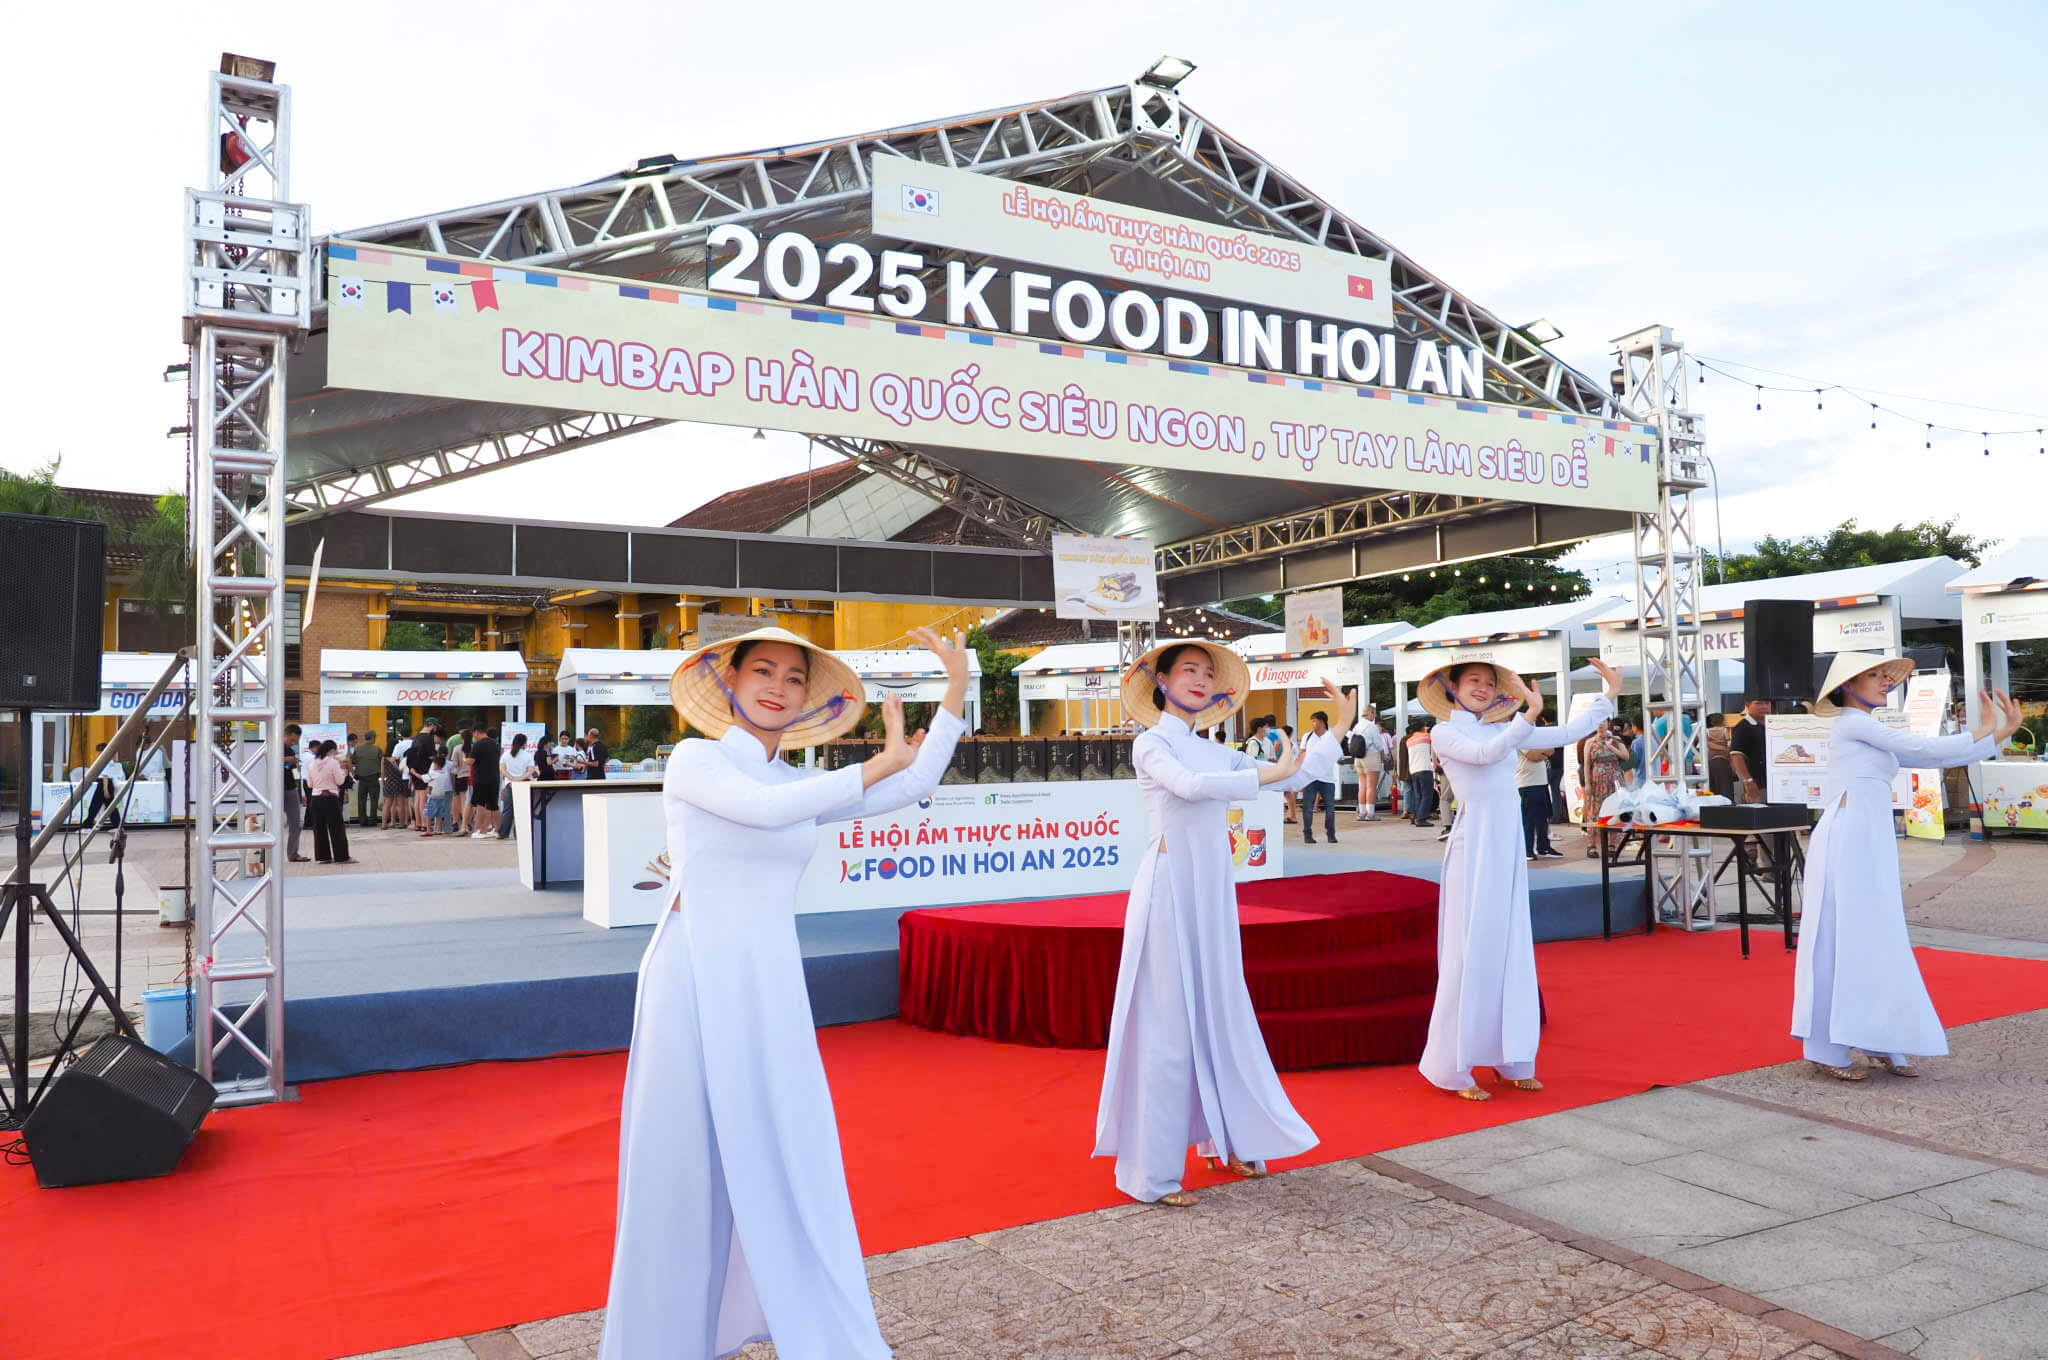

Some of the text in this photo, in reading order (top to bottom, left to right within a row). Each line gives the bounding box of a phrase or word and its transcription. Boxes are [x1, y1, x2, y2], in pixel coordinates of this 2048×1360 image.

[1003, 186, 1301, 272] LỄ HỘI ẨM THỰC HÀN QUỐC 2025
[1111, 244, 1211, 281] TẠI HỘI AN
[707, 223, 1485, 400] 2025 K FOOD IN HOI AN
[502, 327, 734, 397] KIMBAP
[746, 349, 859, 412] HÀN
[870, 363, 1011, 427] QUỐC
[1019, 384, 1118, 440] SIÊU
[1127, 403, 1246, 453] NGON
[1271, 420, 1327, 471] TỰ
[1331, 428, 1398, 469] TAY
[1404, 429, 1473, 477] LÀM
[1478, 439, 1545, 485] SIÊU
[1551, 439, 1589, 489] DỄ
[396, 688, 456, 702] DOOKKI
[839, 812, 1120, 852] LỄ HỘI ẨM THỰC HÀN QUỐC
[942, 853, 967, 876] IN
[974, 850, 1015, 874] HOI
[1021, 848, 1055, 872] AN
[1062, 845, 1119, 870] 2025
